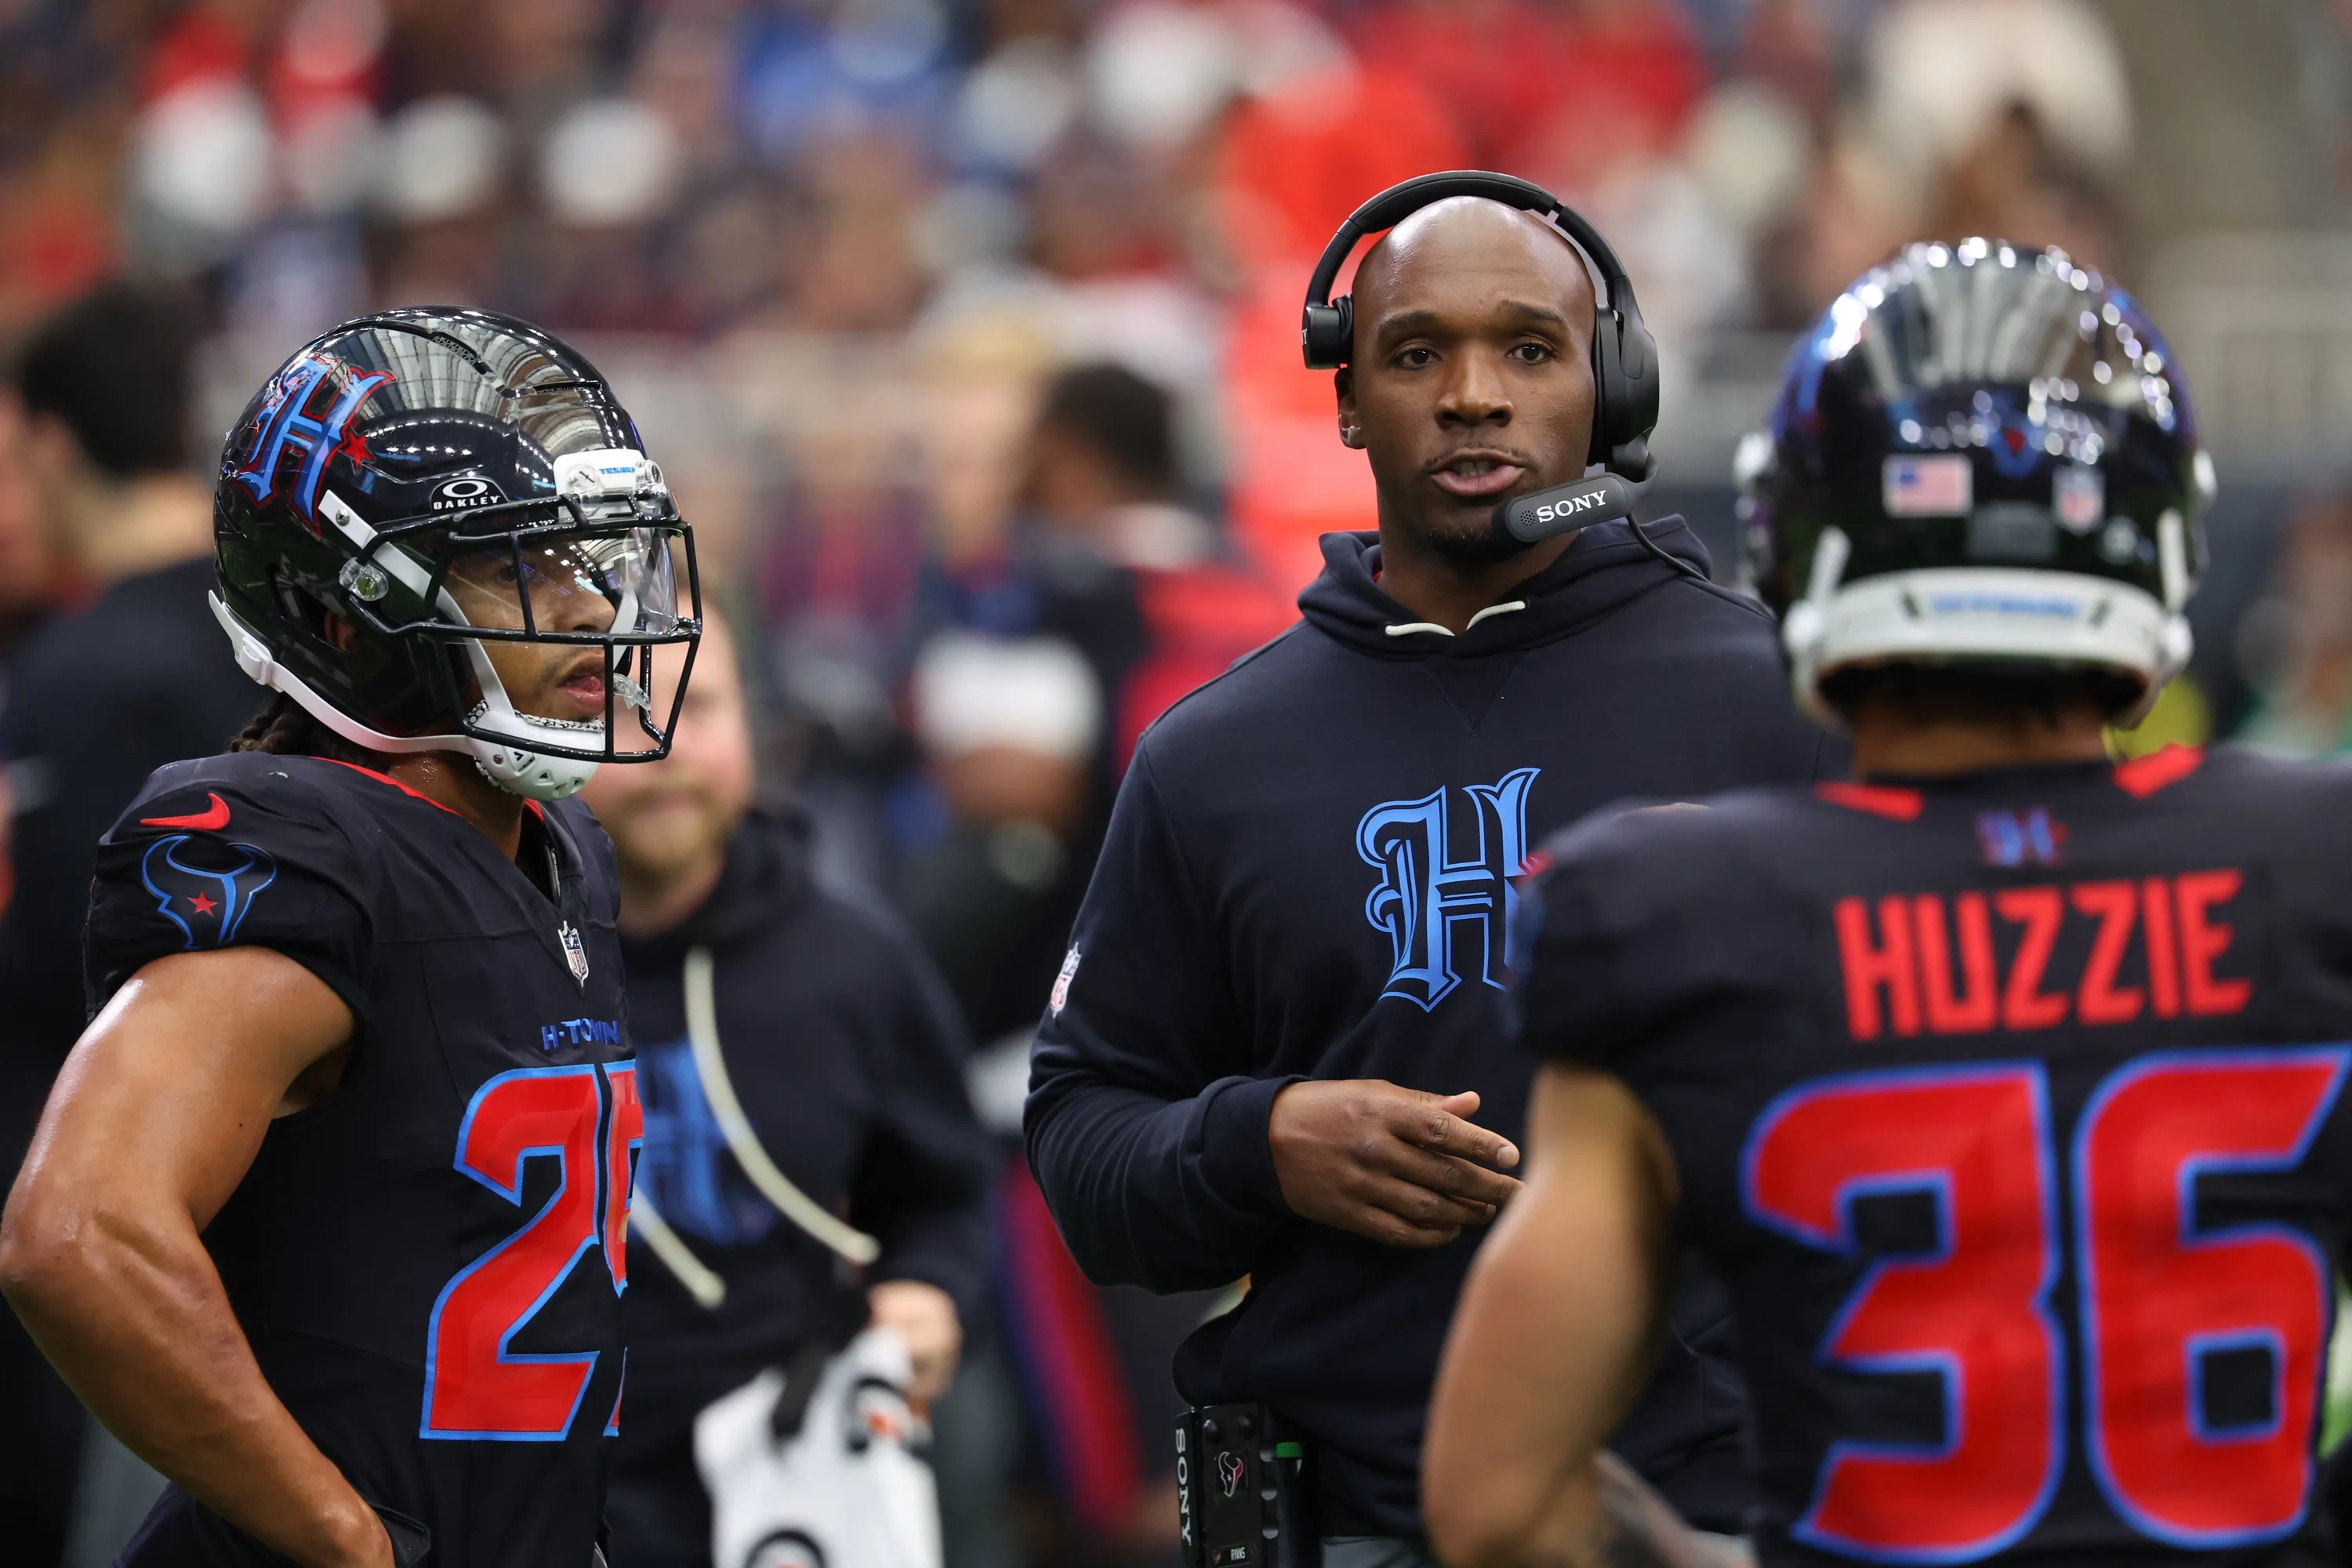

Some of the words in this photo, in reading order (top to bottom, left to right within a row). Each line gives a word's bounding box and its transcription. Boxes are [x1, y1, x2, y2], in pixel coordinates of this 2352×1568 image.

[433, 495, 499, 510] OAKLEY
[1536, 490, 1606, 523] SONY
[1356, 768, 1541, 1012] H
[1836, 869, 2252, 1040] HUZZIE
[541, 1018, 620, 1050] H-TOWN
[1738, 1047, 2352, 1566] 36
[1176, 1428, 1192, 1546] SONY
